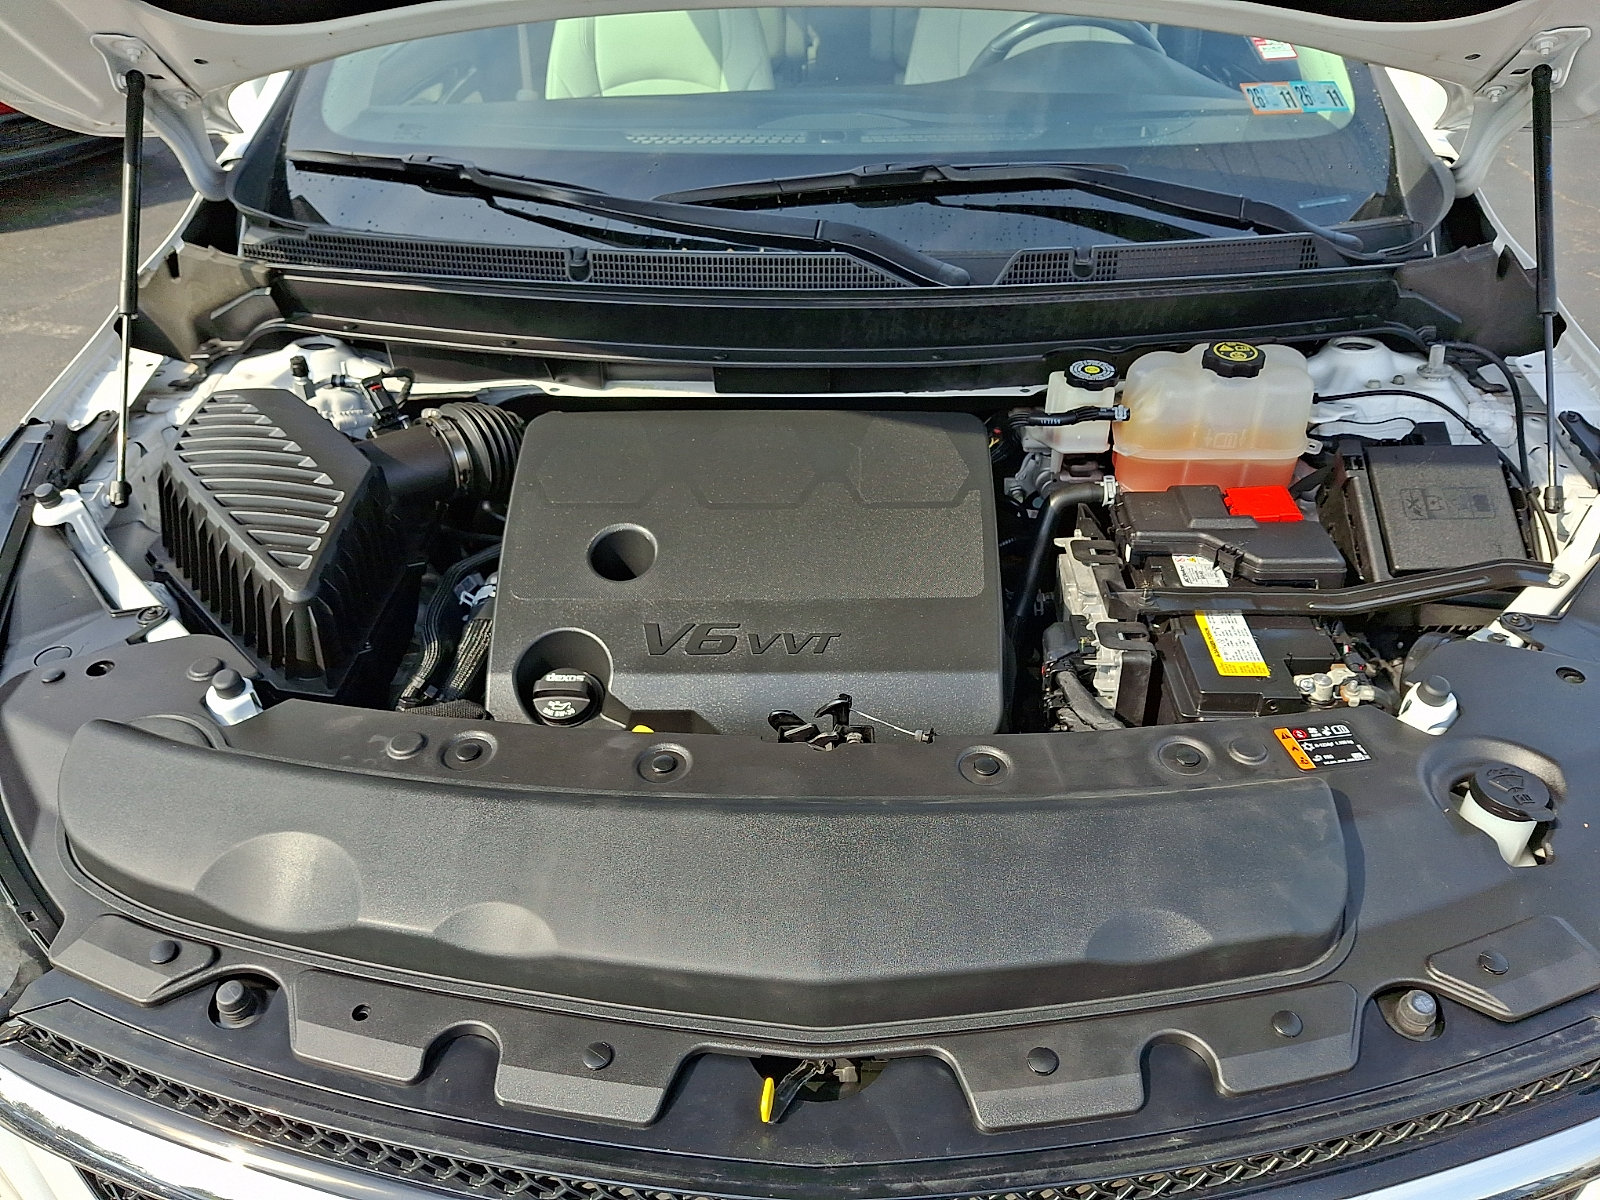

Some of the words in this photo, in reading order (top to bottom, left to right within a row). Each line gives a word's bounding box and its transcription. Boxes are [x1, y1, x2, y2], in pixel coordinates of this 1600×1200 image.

[1247, 88, 1265, 108] 26
[1280, 91, 1298, 108] 11
[1294, 86, 1314, 106] 26
[1326, 89, 1344, 106] 11
[643, 623, 741, 655] V6
[747, 633, 841, 654] VVT
[545, 672, 586, 682] dexos
